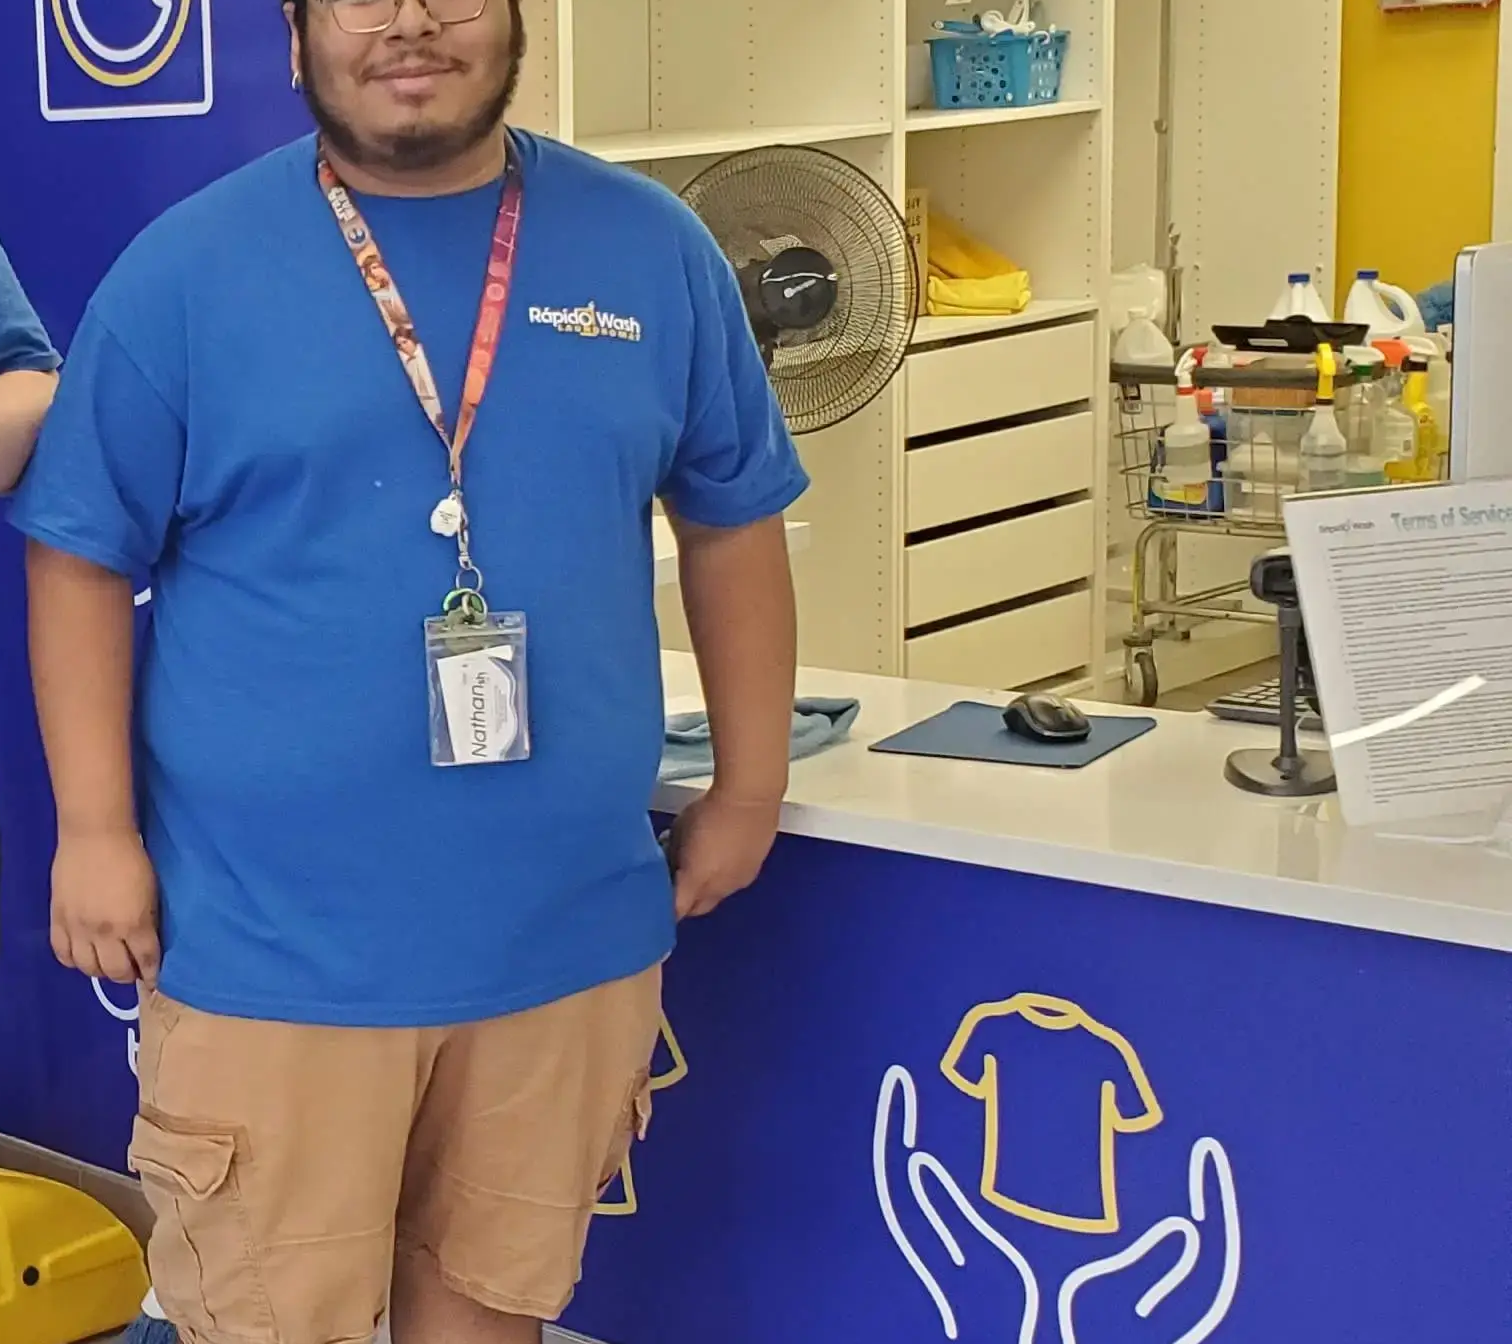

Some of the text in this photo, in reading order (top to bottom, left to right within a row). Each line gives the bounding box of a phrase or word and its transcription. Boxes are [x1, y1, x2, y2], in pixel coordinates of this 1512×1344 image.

[596, 311, 641, 334] Wash
[1391, 512, 1437, 532] Terms
[1441, 507, 1455, 527] of
[471, 684, 488, 758] Nathan
